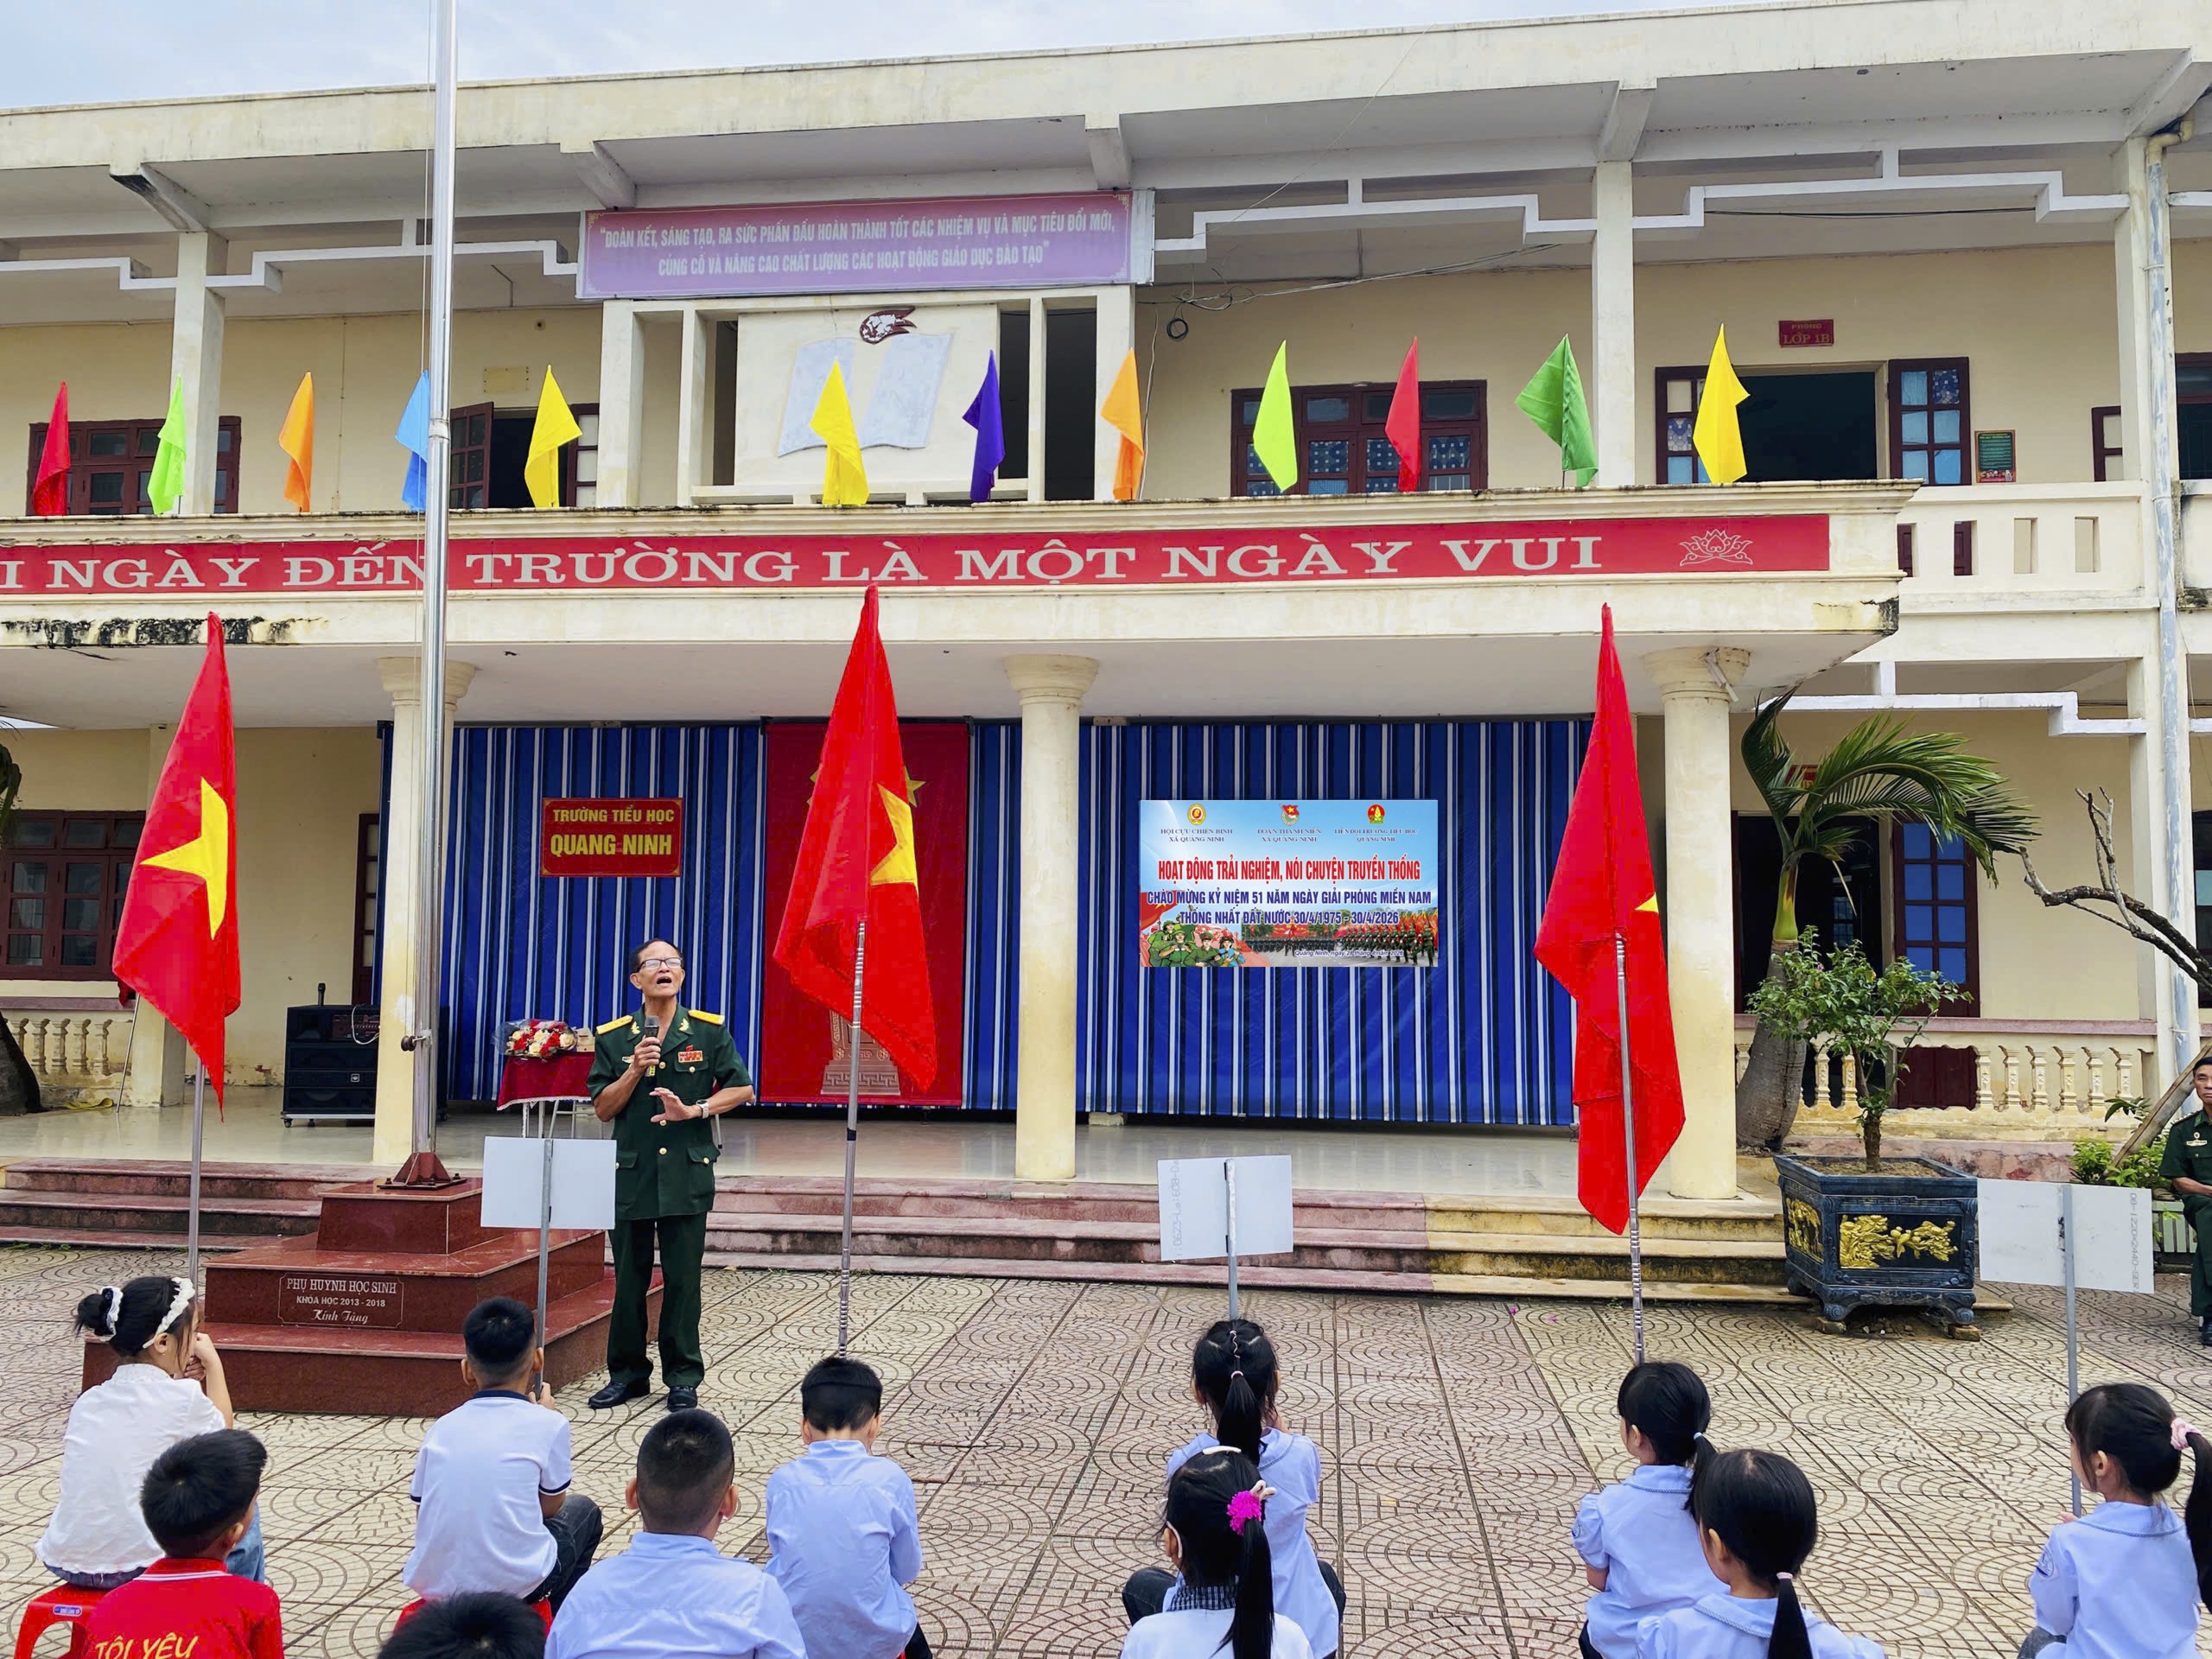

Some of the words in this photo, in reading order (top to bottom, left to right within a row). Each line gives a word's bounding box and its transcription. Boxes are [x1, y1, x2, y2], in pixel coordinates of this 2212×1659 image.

[661, 226, 690, 246] SÁNG
[718, 227, 733, 245] RA
[735, 222, 757, 243] SỨC
[760, 219, 791, 243] PHẤN
[792, 218, 815, 241] ĐẤU
[818, 219, 849, 241] HOÀN
[851, 218, 887, 239] THÀNH
[890, 214, 910, 238] TỐT
[912, 216, 934, 238] CÁC
[938, 214, 973, 242] NHIỆM
[976, 217, 991, 238] VỤ
[994, 213, 1008, 234] VÀ
[1012, 214, 1037, 237] MỤC
[1040, 211, 1065, 232] TIÊU
[1067, 207, 1086, 232] ĐỔI
[708, 253, 721, 275] VÀ
[725, 253, 755, 274] NÂNG
[758, 256, 779, 274] CAO
[782, 249, 810, 272] CHẤT
[813, 252, 849, 275] LƯỢNG
[852, 248, 874, 270] CÁC
[877, 251, 906, 272] HOẠT
[908, 247, 938, 273] ĐỘNG
[942, 245, 968, 267] GIÁO
[971, 248, 993, 270] DỤC
[996, 245, 1019, 265] ĐÀO
[46, 549, 259, 588] NGÀY
[282, 542, 425, 587] ĐẾN
[465, 541, 800, 584] TRƯỜNG
[821, 541, 928, 582] LÀ
[954, 539, 1135, 585] MỘT
[1161, 533, 1412, 578] NGÀY
[1440, 537, 1604, 571] VUI
[553, 806, 607, 823] TRƯỜNG
[612, 804, 642, 822] TIỂU
[646, 809, 675, 825] HỌC
[550, 834, 616, 857] QUANG
[622, 834, 672, 855] NINH
[1158, 860, 1184, 884] HOẠT
[1186, 856, 1214, 884] ĐỘNG
[1216, 854, 1238, 880] TRẢI
[1241, 856, 1283, 884] NGHIỆM,
[1286, 856, 1303, 880] NÓI
[1306, 856, 1344, 884] CHUYỆN
[1347, 854, 1385, 880] TRUYỀN
[1388, 853, 1421, 880] THỐNG
[1147, 889, 1173, 904] CHÀO
[1176, 889, 1205, 904] MỪNG
[1210, 887, 1221, 904] KỶ
[1224, 889, 1249, 906] NIỆM
[1252, 891, 1262, 904] 51
[1267, 889, 1291, 904] NĂM
[1293, 888, 1319, 904] NGÀY
[1321, 887, 1341, 904] GIẢI
[1344, 888, 1377, 904] PHÓNG
[1380, 887, 1406, 904] MIỀN
[1408, 891, 1432, 904] NAM
[1179, 906, 1212, 925] THỐNG
[1215, 906, 1241, 924] NHẤT
[1243, 906, 1262, 924] ĐẤT
[1264, 908, 1291, 924] NƯỚC
[1294, 912, 1342, 925] 30/4/1975
[1351, 912, 1399, 925] 30/4/2026
[287, 1278, 308, 1293] PHỤ
[309, 1279, 346, 1292] HUYNH
[349, 1281, 370, 1295] HỌC
[371, 1282, 397, 1294] SINH
[296, 1294, 319, 1305] KHÓA
[321, 1297, 339, 1306] HỌC
[366, 1299, 385, 1307] 2018
[311, 1309, 339, 1321] Kính
[95, 1636, 133, 1659] TÔI
[143, 1632, 199, 1659] YÊU
